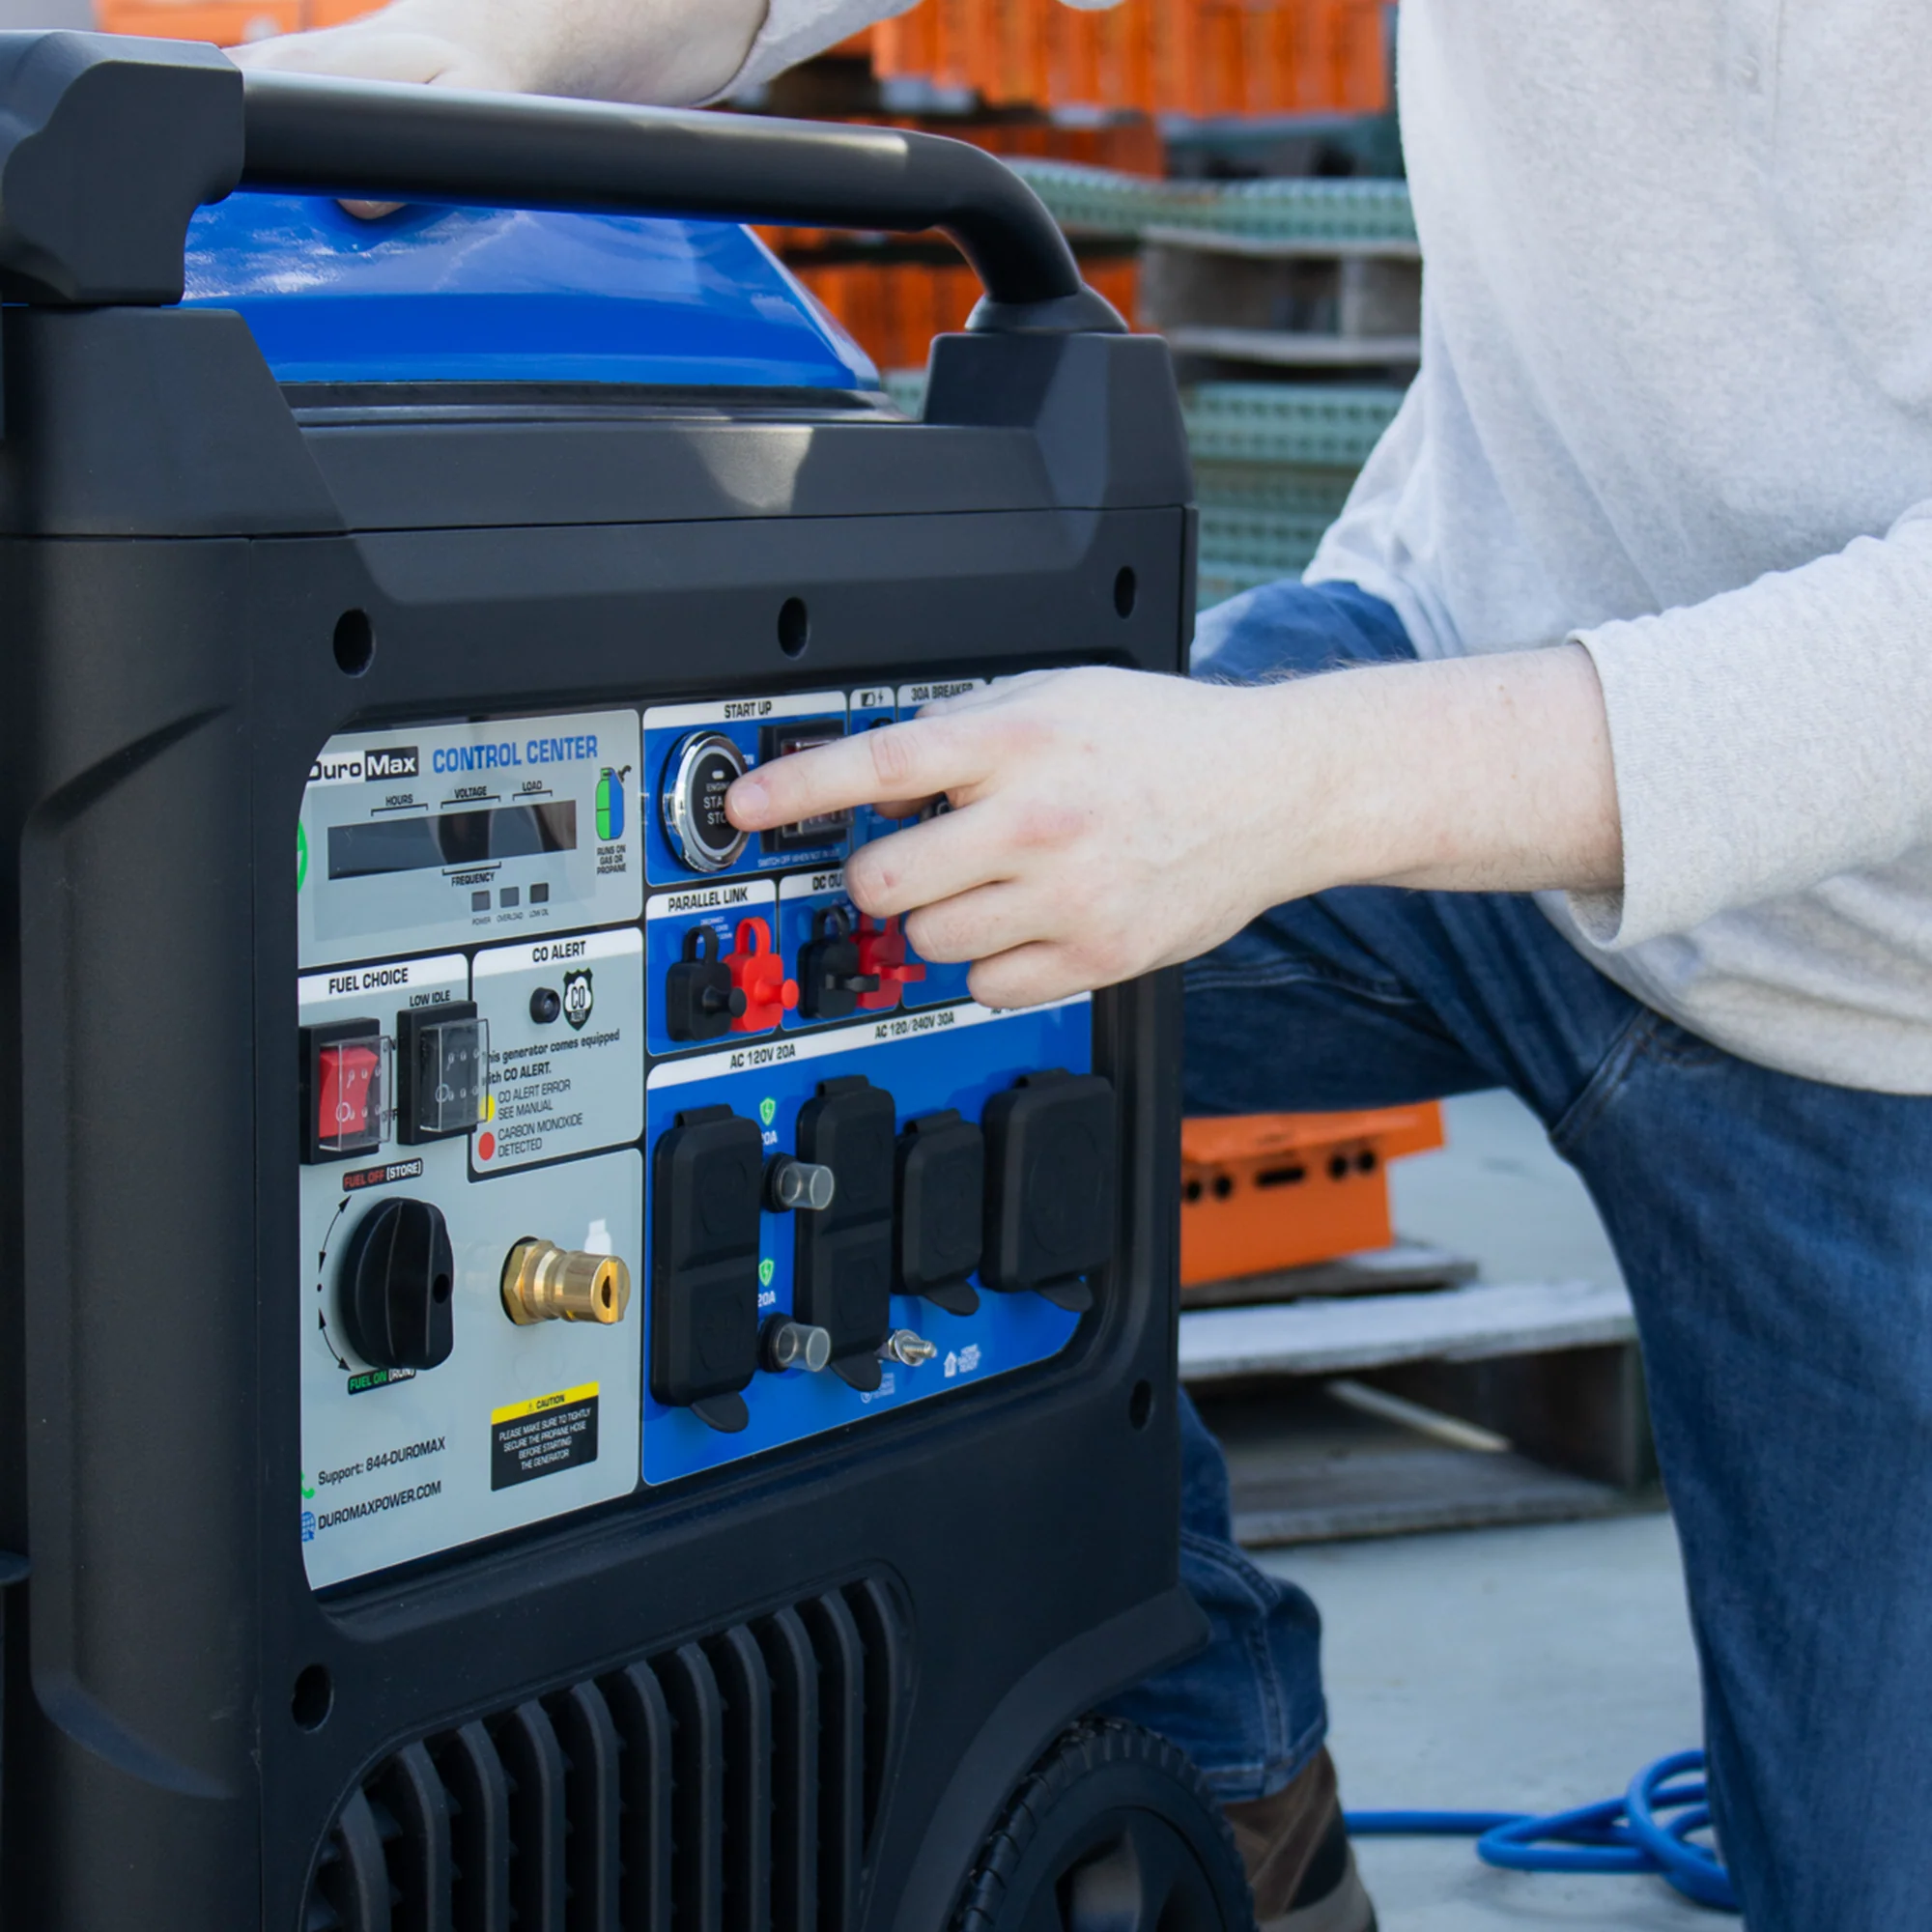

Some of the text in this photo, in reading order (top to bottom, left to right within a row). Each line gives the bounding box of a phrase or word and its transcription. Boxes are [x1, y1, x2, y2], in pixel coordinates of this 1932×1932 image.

[911, 687, 930, 701] 30A
[724, 701, 772, 718] START UP
[433, 735, 598, 773] CONTROL CENTER
[454, 786, 487, 799] VOLTAGE
[522, 781, 543, 791] LOAD
[385, 794, 413, 806] HOURS
[703, 795, 723, 810] STA
[451, 871, 496, 887] FREQUENCY
[812, 875, 826, 891] DC
[668, 887, 748, 912] PARALLEL LINK
[532, 940, 586, 963] CO ALERT
[328, 968, 409, 996] FUEL CHOICE
[410, 990, 451, 1008] LOW IDLE
[571, 984, 585, 1009] CO
[875, 1011, 954, 1039] AC 120/240V 30A
[502, 1043, 549, 1065] generator
[550, 1037, 579, 1053] comes
[581, 1029, 620, 1049] equipped
[730, 1043, 796, 1068] AC 120V 20A
[503, 1066, 518, 1082] CO
[520, 1061, 552, 1079] ALERT.
[498, 1079, 571, 1104] CO ALERT ERROR
[498, 1099, 554, 1121] SEE MANUAL
[498, 1113, 583, 1141] CARBON MONOXIDE
[761, 1130, 778, 1146] 0A
[498, 1137, 543, 1157] DETECTED
[344, 1174, 366, 1189] FUEL
[367, 1169, 385, 1184] OFF
[350, 1374, 372, 1391] FUEL
[373, 1370, 387, 1384] ON
[536, 1394, 565, 1409] CAUTION
[498, 1407, 591, 1441] PLEASE MAKE SURE TO TIGHTLY
[503, 1420, 586, 1452] SECURE THE PROPANE HOSE
[518, 1435, 572, 1460] BEFORE STARTING
[318, 1436, 446, 1486] Support: 844-DUROMAX
[522, 1448, 570, 1470] THE GENERATOR
[318, 1480, 441, 1530] DUROMAXPOWER.COM
